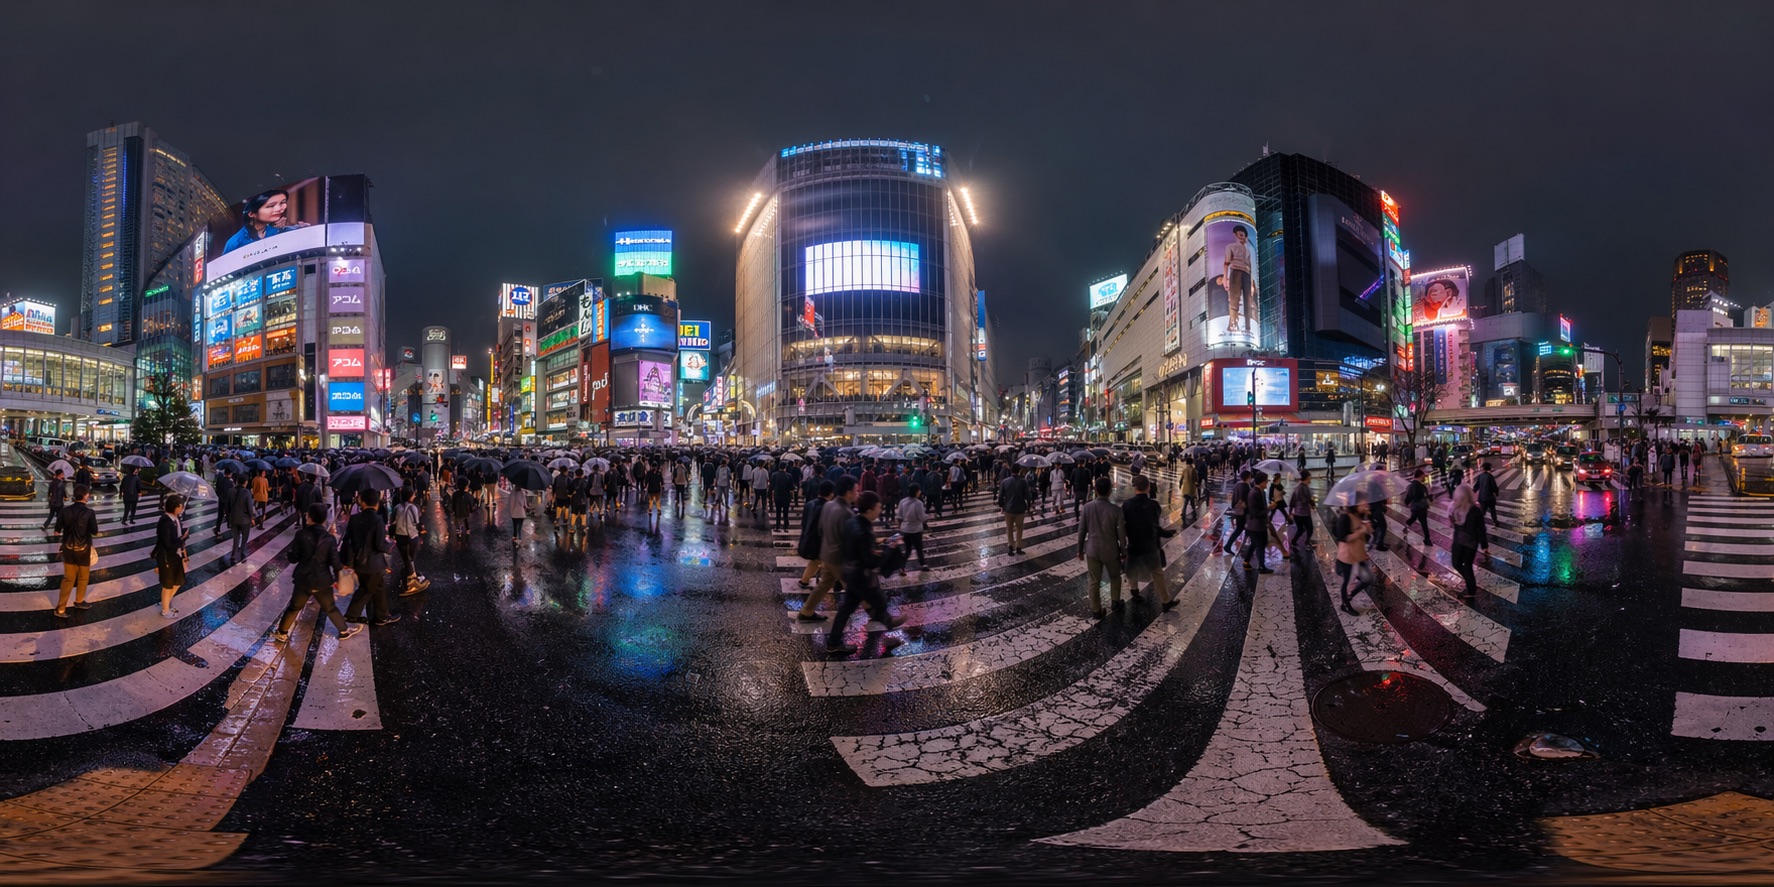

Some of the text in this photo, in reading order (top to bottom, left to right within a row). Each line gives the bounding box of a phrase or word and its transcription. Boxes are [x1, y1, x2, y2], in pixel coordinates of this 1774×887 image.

[332, 295, 361, 305] アコム
[332, 358, 361, 367] アコム
